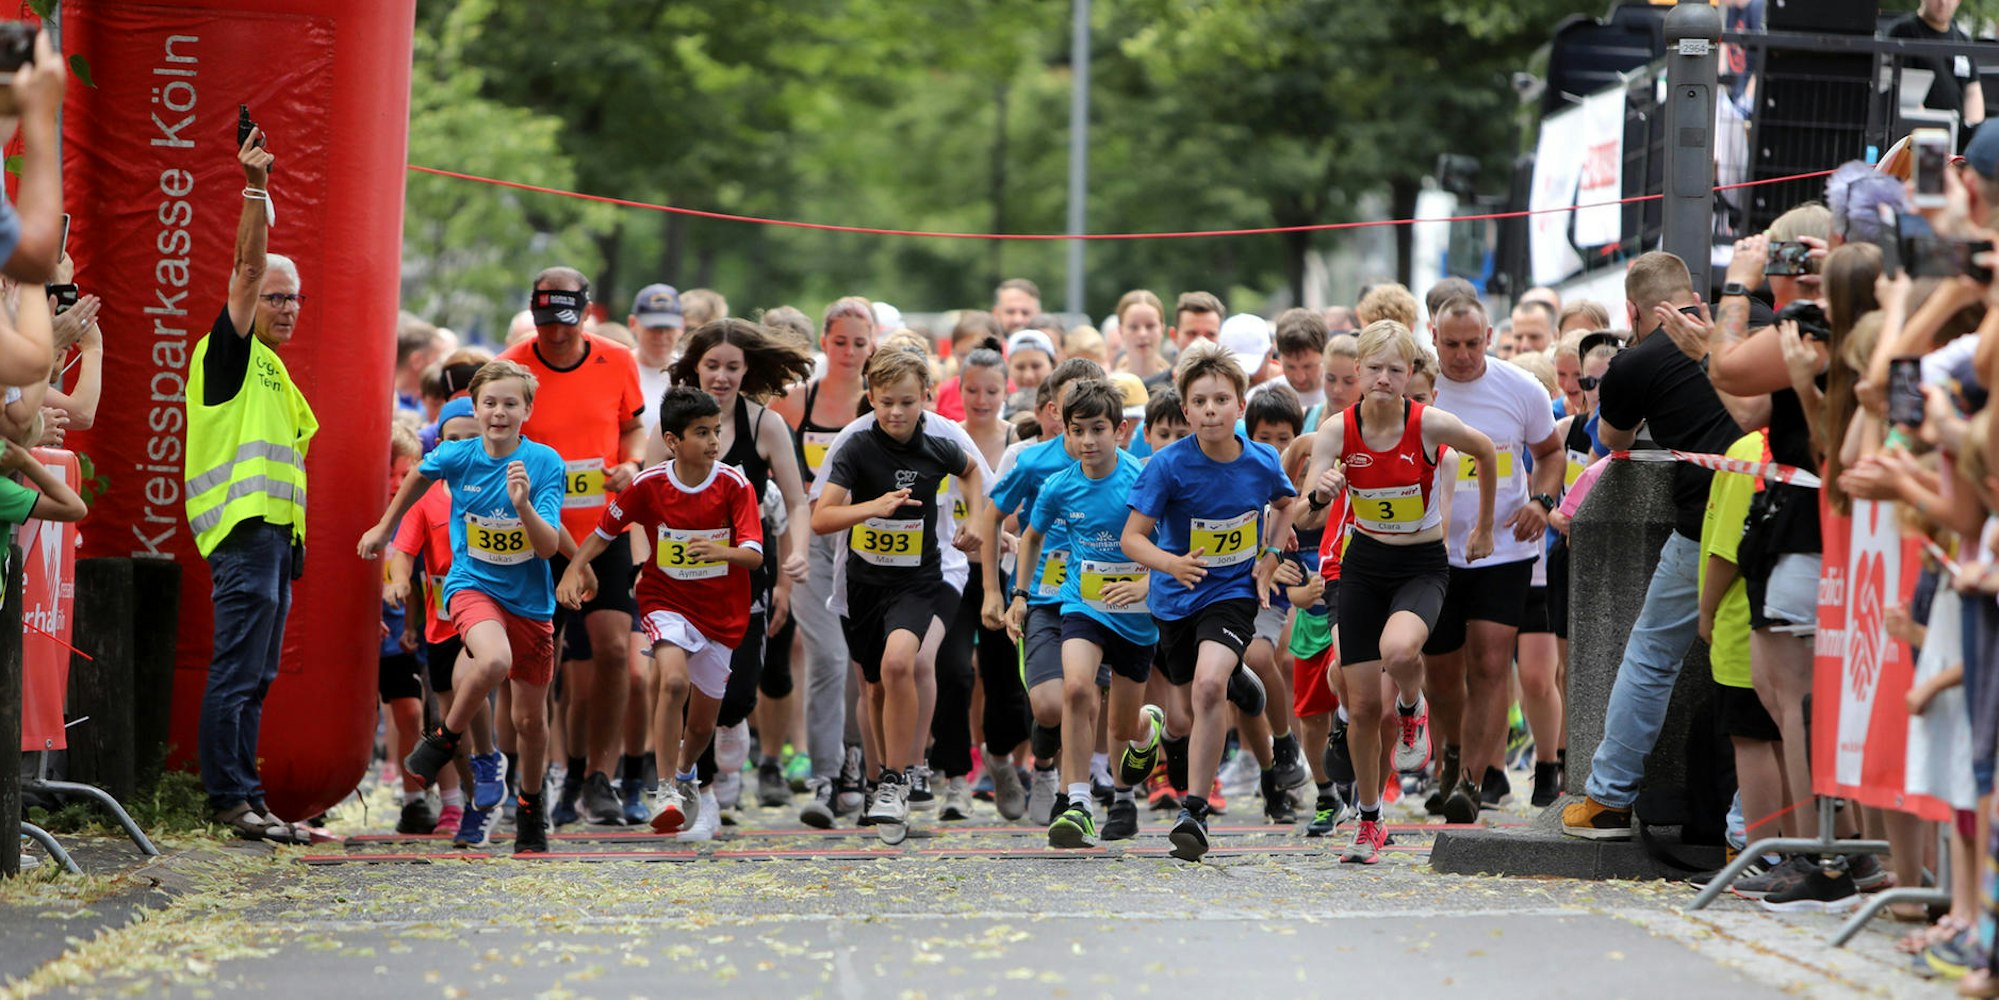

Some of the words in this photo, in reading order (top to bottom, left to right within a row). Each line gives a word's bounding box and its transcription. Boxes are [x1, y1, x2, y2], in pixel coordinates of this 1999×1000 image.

[1683, 44, 1707, 53] 2964
[151, 35, 199, 148] Köln
[131, 168, 194, 560] Kreissparkasse
[257, 373, 284, 392] Tem
[895, 470, 918, 482] CR7
[1378, 501, 1395, 520] 3
[1378, 522, 1401, 530] Clara
[478, 529, 525, 552] 388
[863, 530, 910, 553] 393
[1213, 530, 1242, 553] 79
[489, 552, 513, 563] Lukas
[875, 555, 894, 564] Max
[1217, 556, 1237, 564] Jona
[678, 568, 708, 578] Ayman
